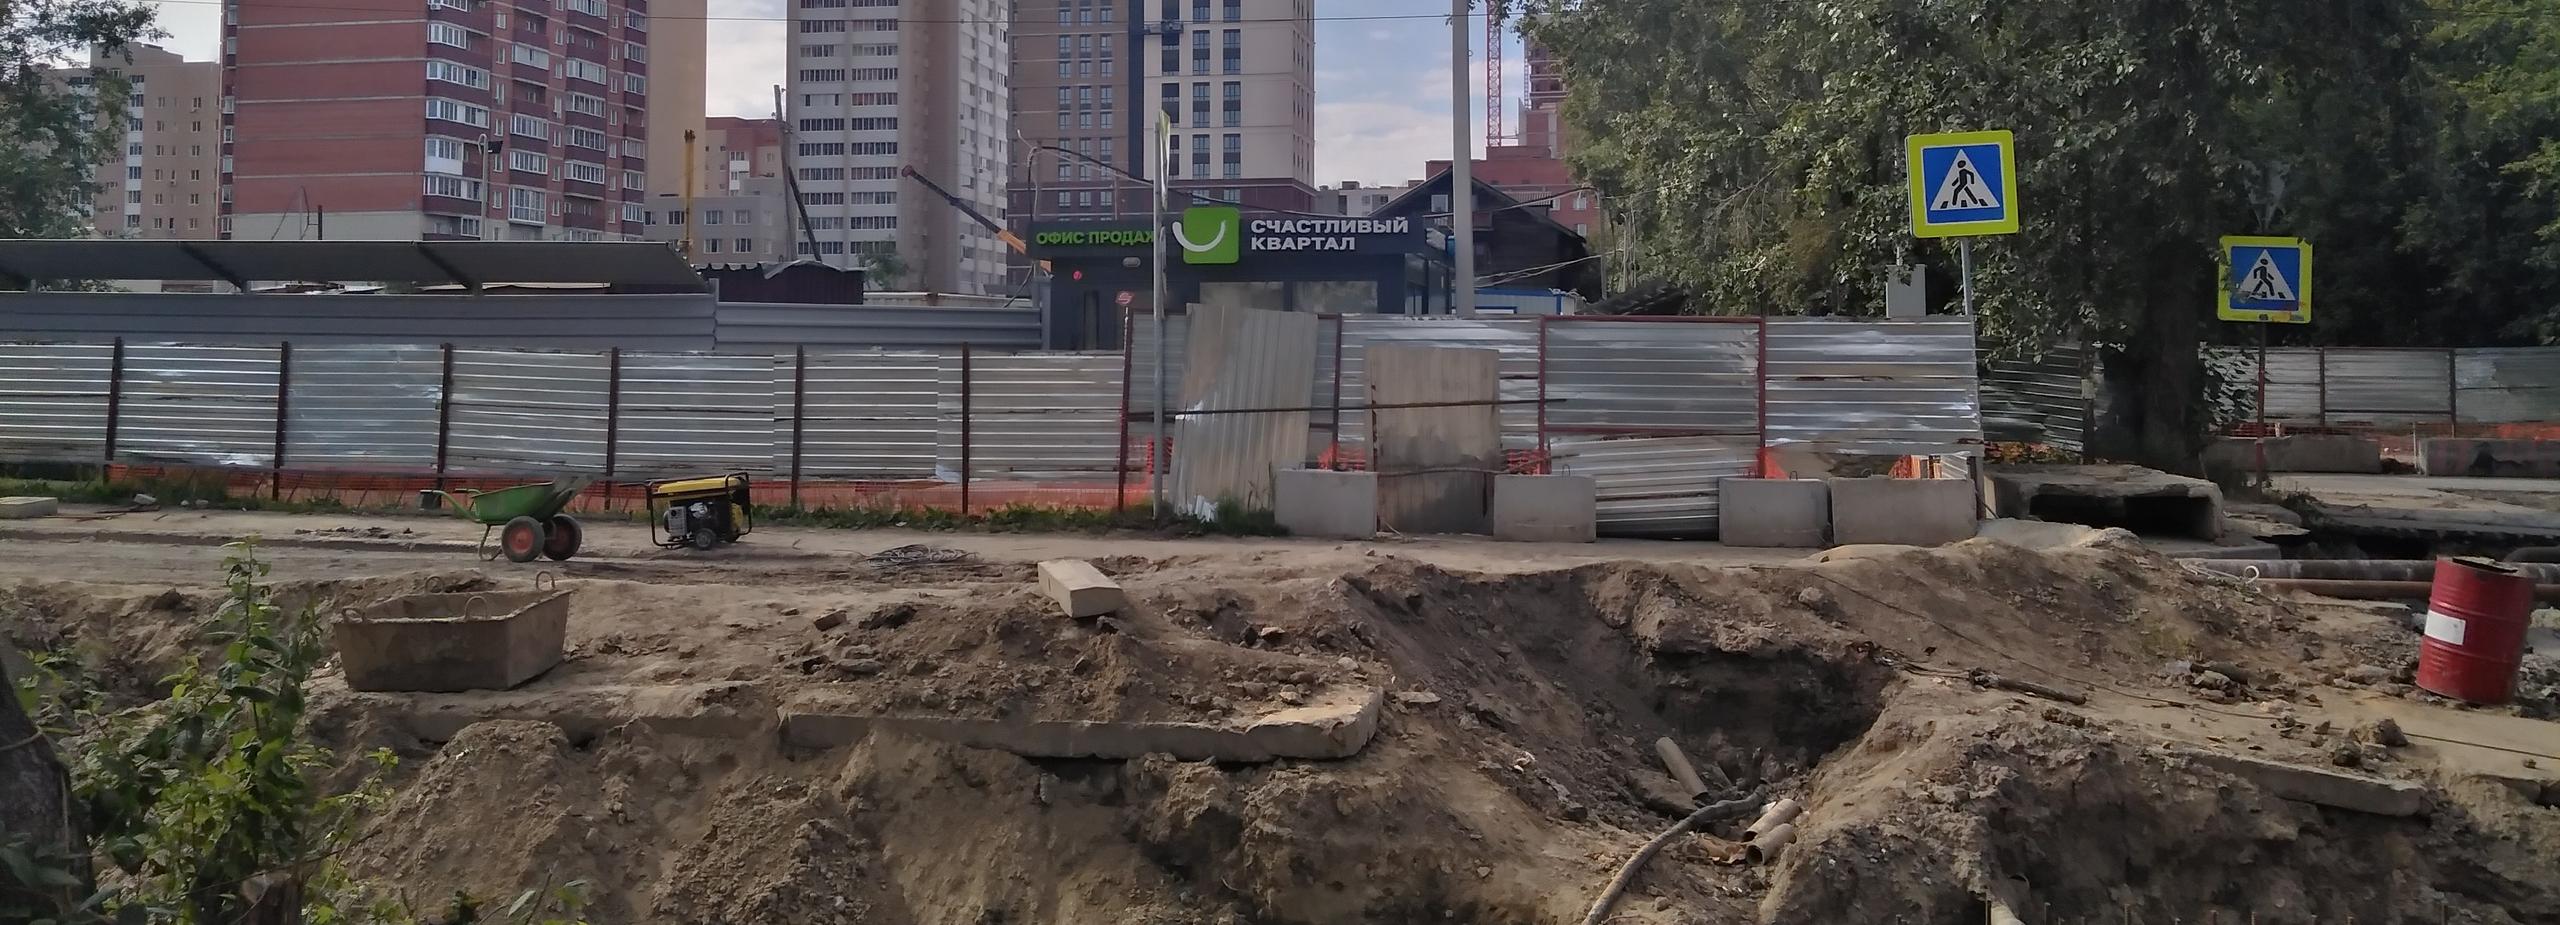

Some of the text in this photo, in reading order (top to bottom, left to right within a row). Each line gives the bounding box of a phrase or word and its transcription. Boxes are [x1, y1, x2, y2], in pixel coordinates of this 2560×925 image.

[1251, 217, 1408, 233] СЧАСТЛИВЫЙ
[1036, 231, 1085, 244] ОФИС
[1251, 237, 1355, 250] КВАРТАЛ
